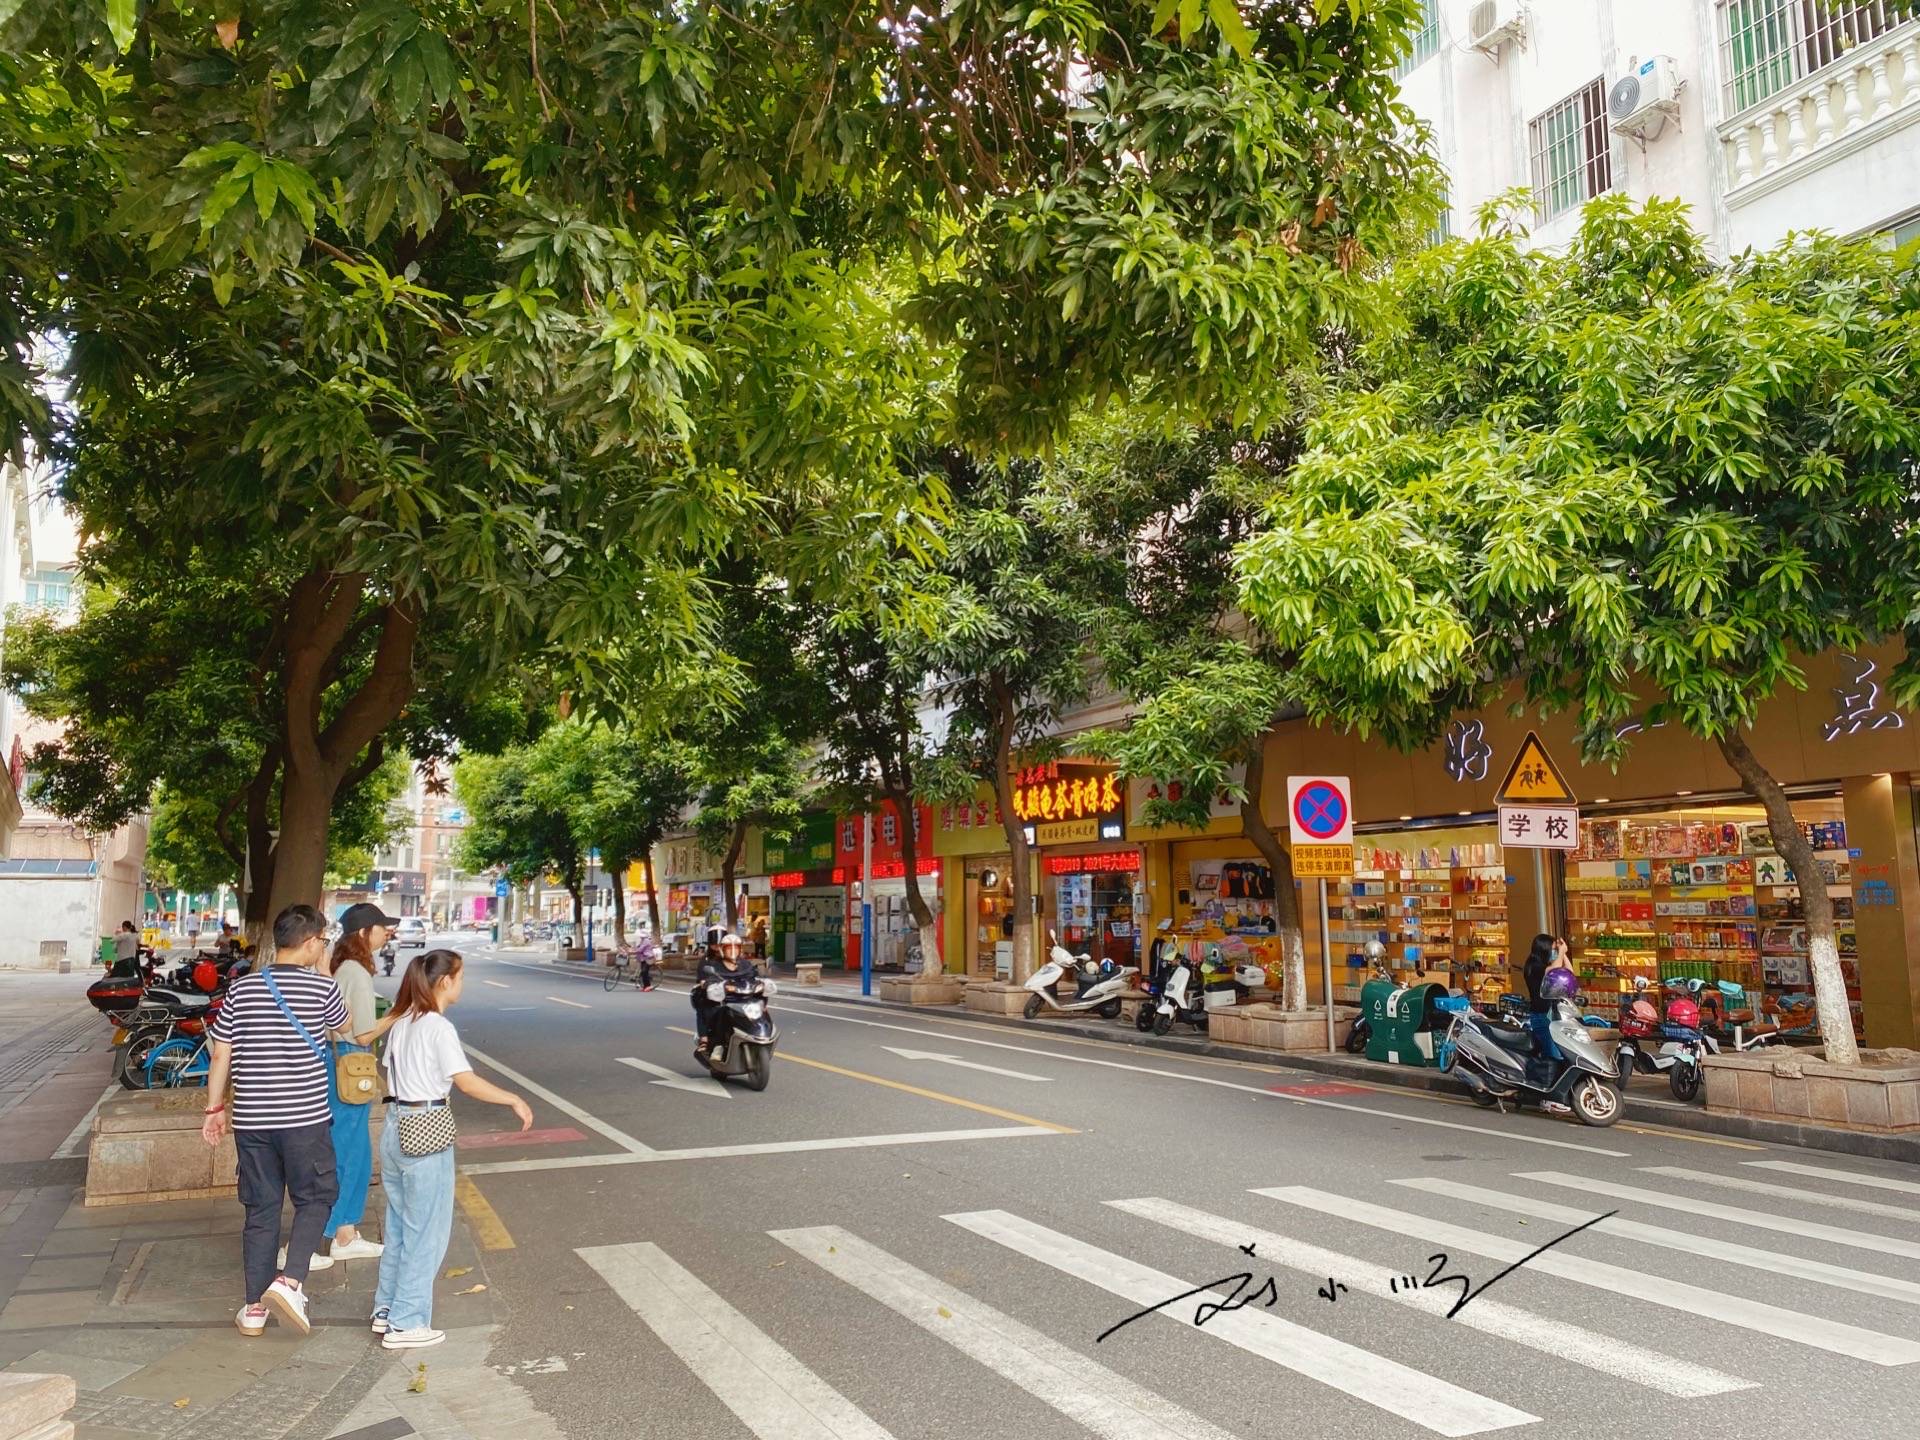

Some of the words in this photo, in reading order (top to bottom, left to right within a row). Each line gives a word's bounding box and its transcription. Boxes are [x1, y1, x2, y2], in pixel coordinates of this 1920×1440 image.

[1508, 814, 1569, 840] 学校
[1295, 847, 1353, 859] 视频抓拍路段
[1084, 853, 1140, 872] 2021年大众点
[1296, 861, 1352, 872] 违停车请即离
